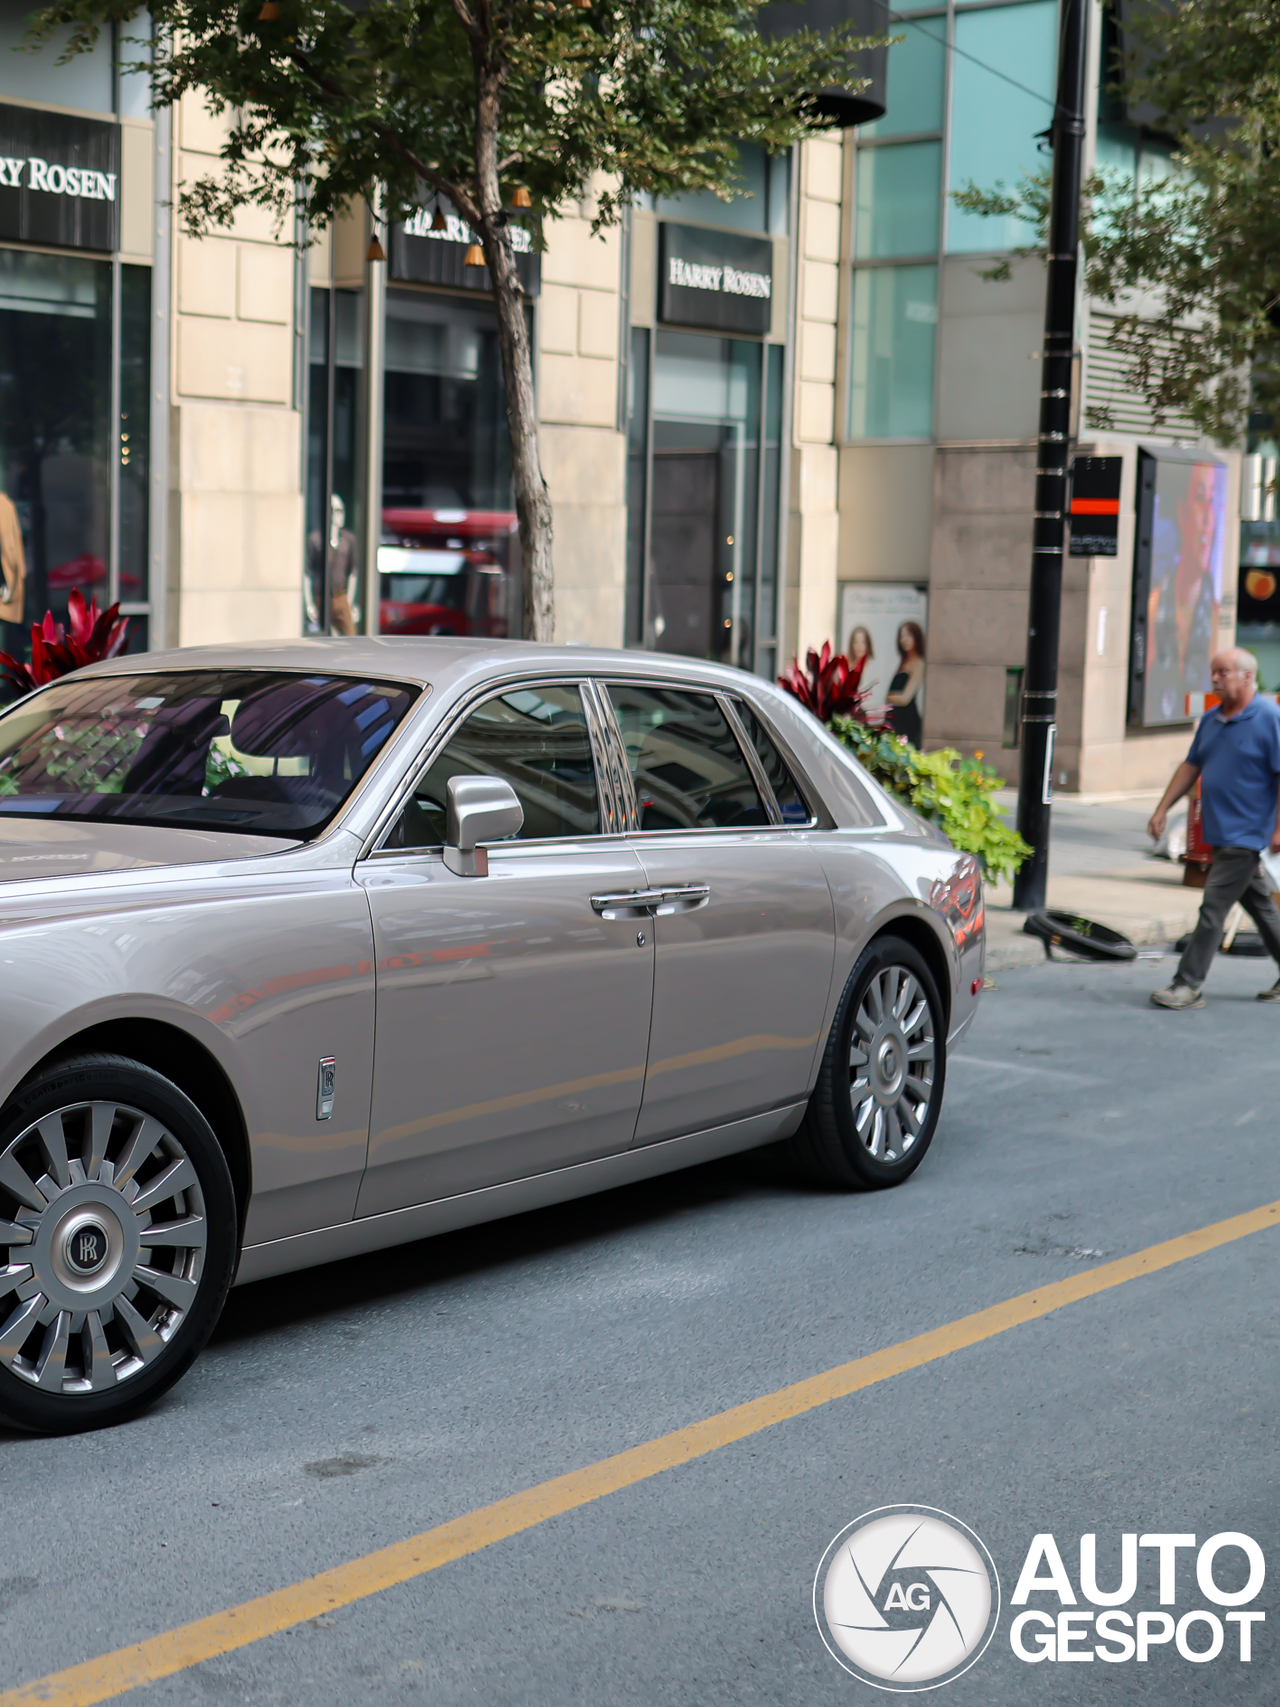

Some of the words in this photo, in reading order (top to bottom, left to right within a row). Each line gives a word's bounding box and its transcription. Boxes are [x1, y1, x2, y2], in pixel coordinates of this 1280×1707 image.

[27, 157, 117, 201] ROSEN
[669, 257, 723, 291] HARRY
[723, 265, 771, 299] ROSEN
